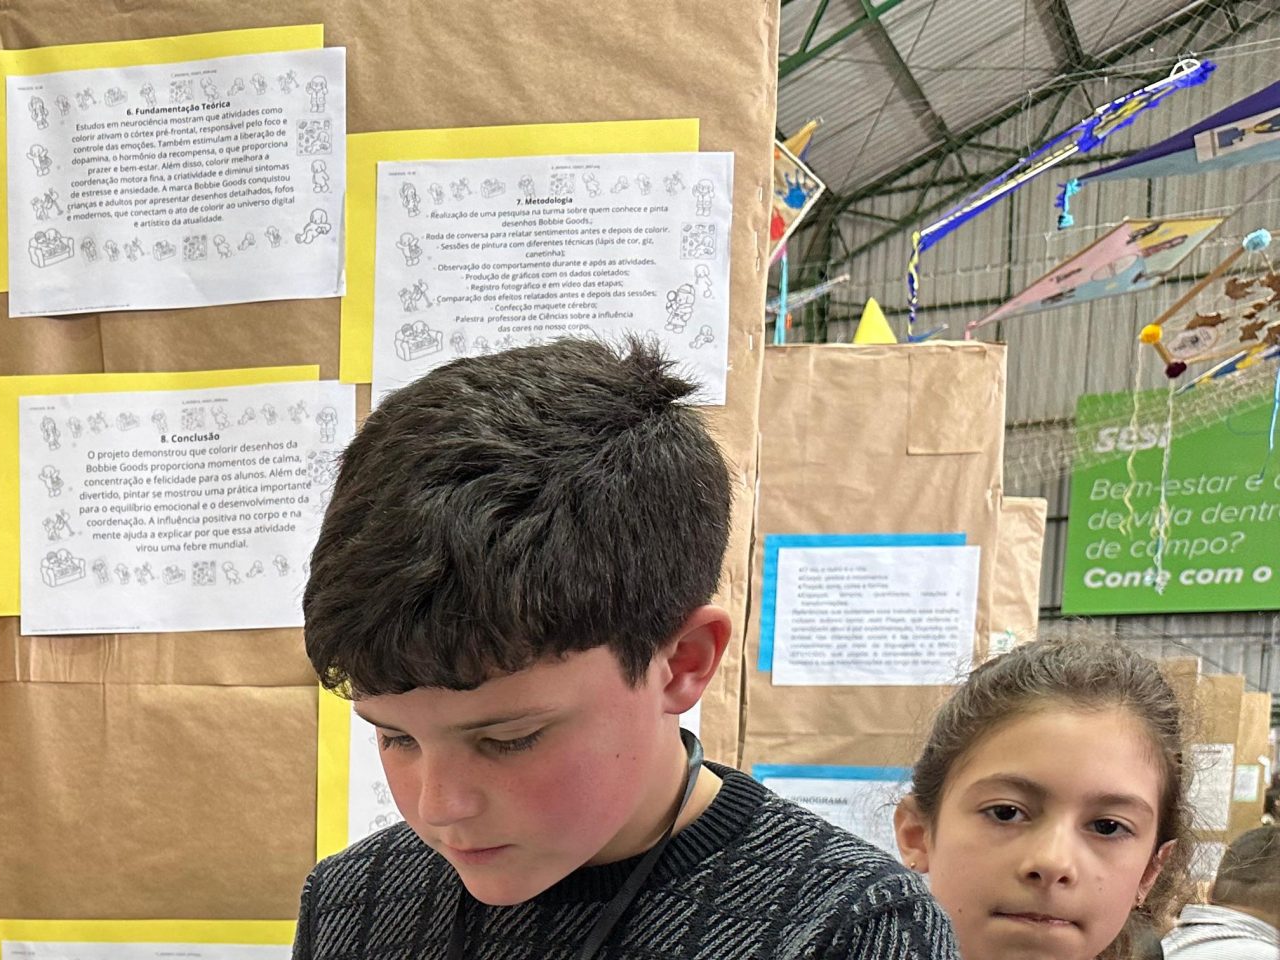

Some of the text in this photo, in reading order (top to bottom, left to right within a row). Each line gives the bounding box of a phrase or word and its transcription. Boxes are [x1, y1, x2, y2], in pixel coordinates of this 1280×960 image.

[126, 99, 230, 116] 6. Fundamentação Teórica
[524, 195, 572, 205] Metodologia
[160, 431, 219, 443] 8. Conclusão
[87, 439, 297, 461] O projeto demonstrou que colorir desenhos da
[85, 454, 301, 473] Bobbie Goods proporciona momentos de calma,
[83, 467, 309, 487] concentração e felicidade para os alunos. Além de
[1090, 474, 1237, 500] Bem-estar
[79, 480, 311, 500] divertido, pintar se mostrou uma prática importante
[78, 494, 309, 516] para o equilíbrio emocional e o desenvolvimento da
[86, 516, 145, 527] coordenação.
[148, 516, 155, 525] A
[156, 515, 200, 524] influência
[201, 513, 237, 525] positiva
[253, 510, 279, 521] corpo
[281, 510, 287, 518] e
[1088, 509, 1125, 530] de
[1201, 502, 1280, 524] dentr
[92, 531, 121, 539] mente
[123, 530, 147, 541] ajuda
[157, 529, 192, 540] explicar
[194, 529, 210, 539] por
[211, 528, 229, 538] que
[231, 526, 252, 535] essa
[253, 522, 295, 533] atividade
[135, 539, 248, 552] virou uma febre mundial.
[1086, 531, 1245, 560] de campo?
[1084, 566, 1272, 588] Conte com o
